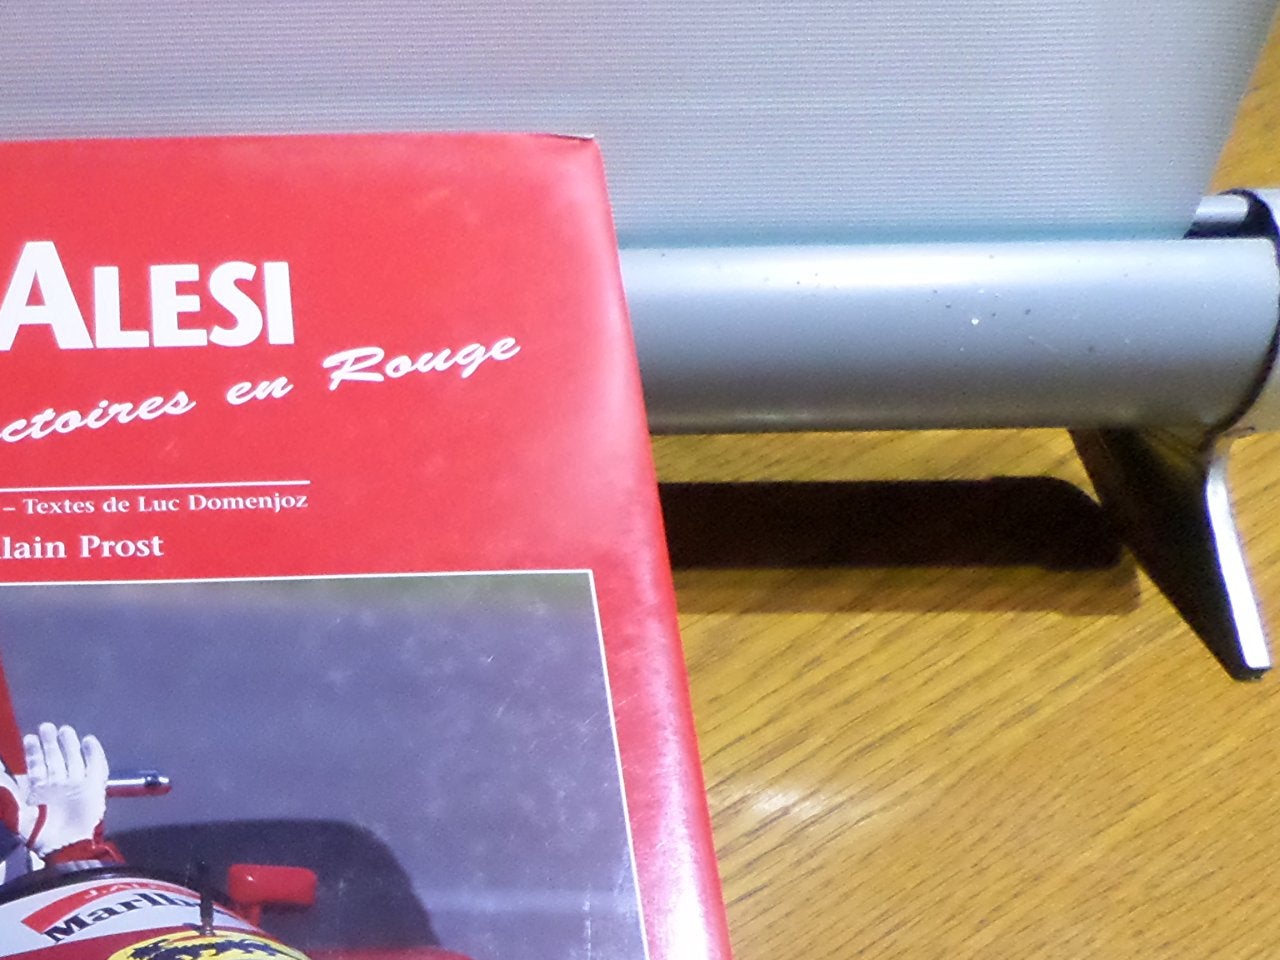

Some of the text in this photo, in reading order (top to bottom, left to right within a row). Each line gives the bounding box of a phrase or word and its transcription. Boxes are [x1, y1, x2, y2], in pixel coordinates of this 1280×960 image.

[225, 376, 294, 405] en
[322, 336, 521, 391] Rouge
[23, 498, 95, 515] Textes
[102, 496, 130, 513] de
[138, 496, 180, 512] Luc
[188, 492, 308, 513] Domenjoz
[80, 534, 165, 558] Prost
